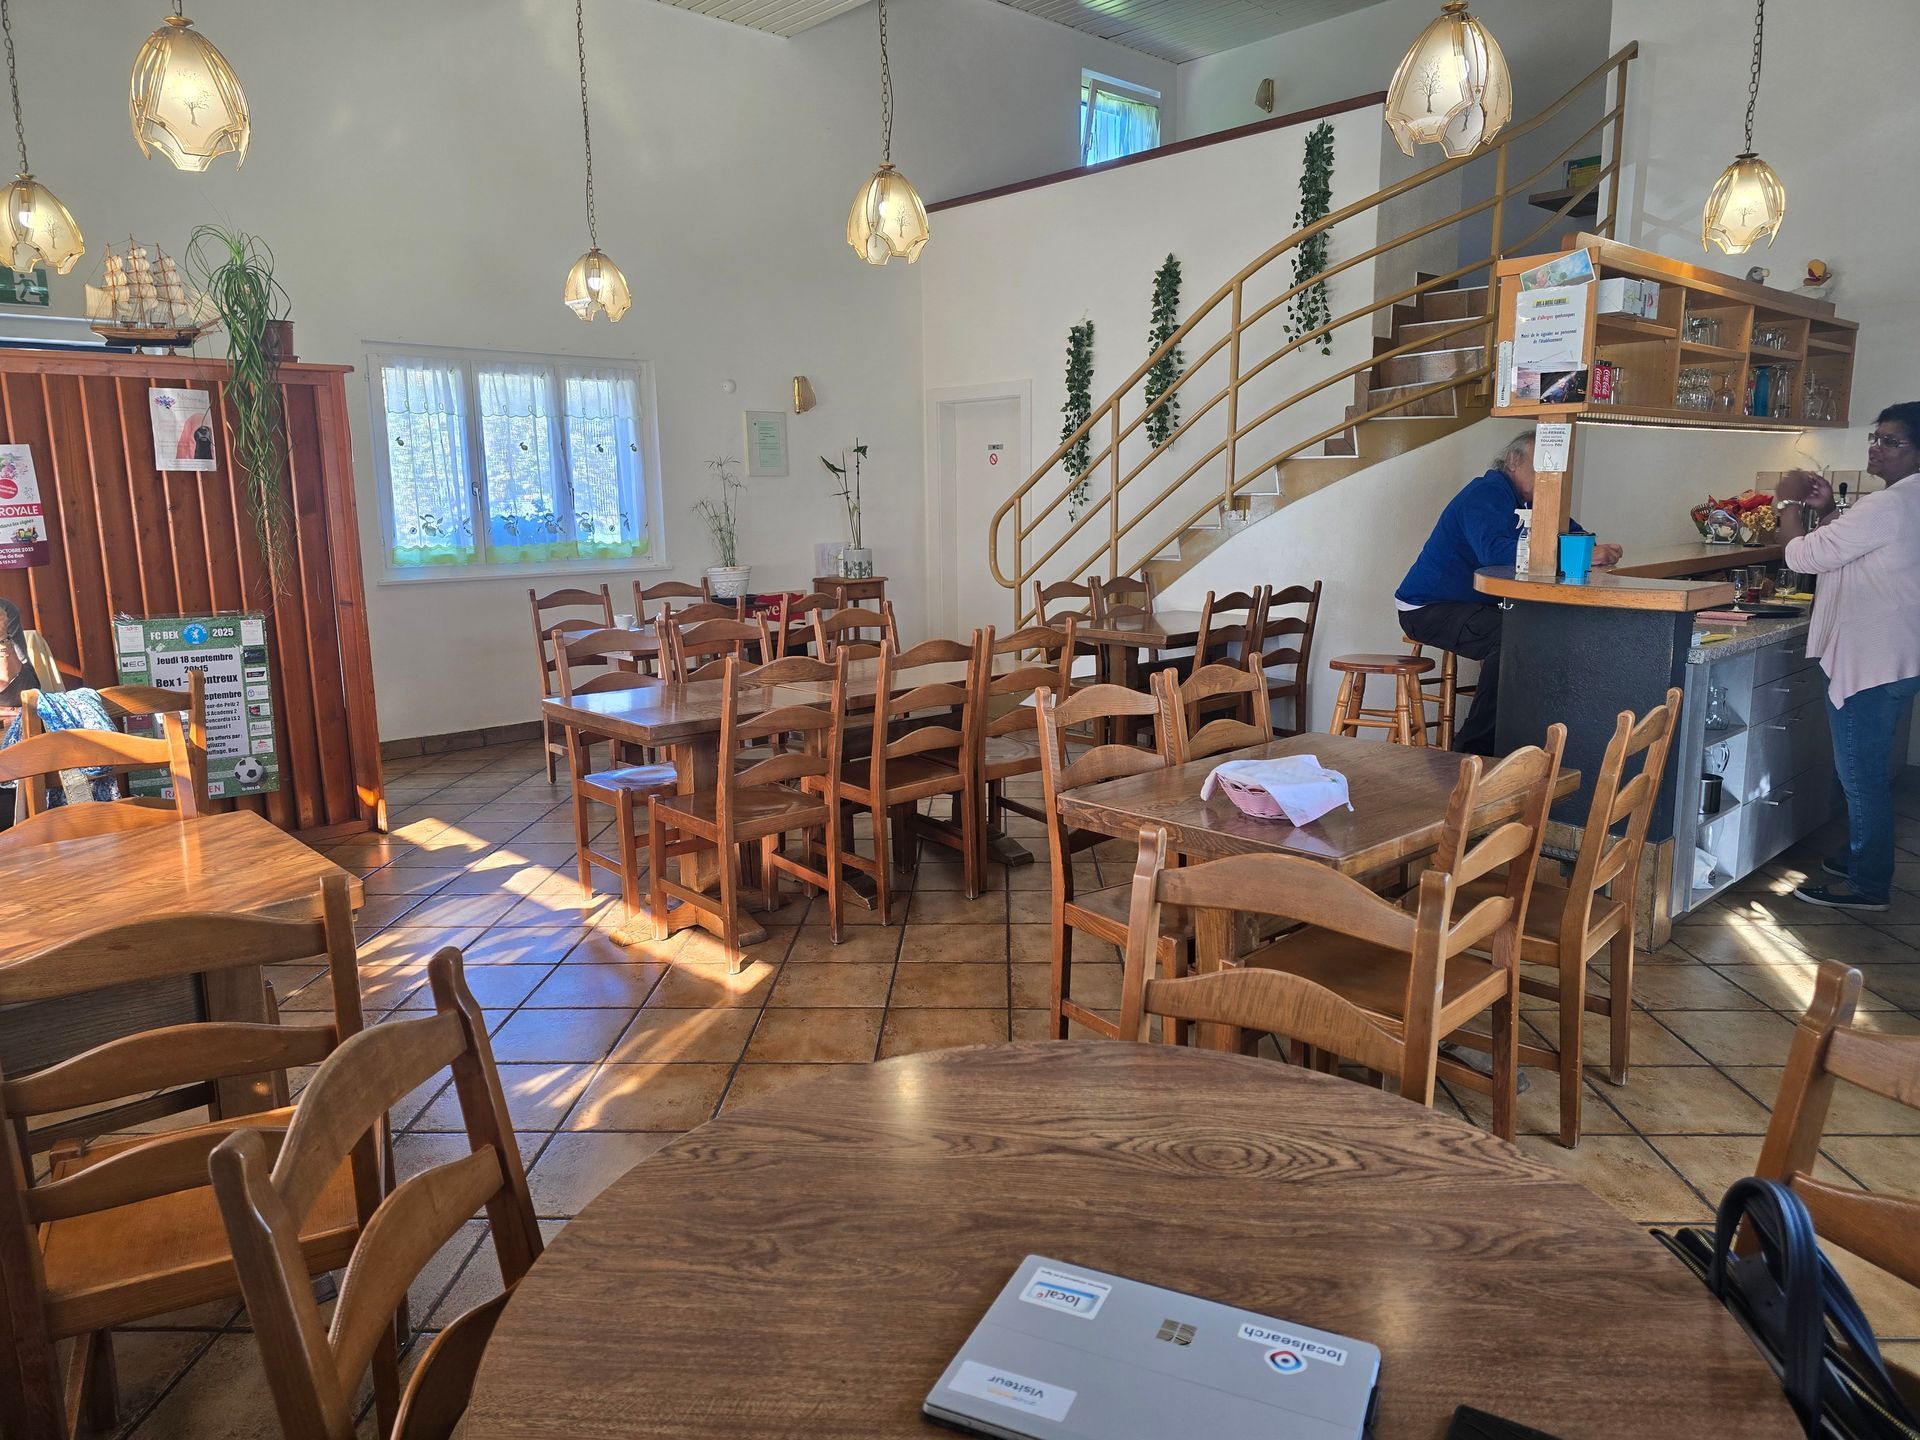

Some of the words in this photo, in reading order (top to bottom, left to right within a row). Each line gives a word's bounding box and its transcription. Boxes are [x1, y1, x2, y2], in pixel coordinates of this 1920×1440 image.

[0, 505, 39, 517] ROYALE
[150, 632, 161, 640] FC
[163, 630, 179, 640] BEX
[212, 628, 234, 637] 2025
[157, 657, 179, 665] Jeudi
[190, 654, 234, 663] septembre
[155, 679, 175, 688] Bex
[204, 691, 242, 701] eptembre
[1044, 1289, 1081, 1307] local
[1244, 1326, 1342, 1362] localsearch
[988, 1376, 1044, 1399] Visiteur
